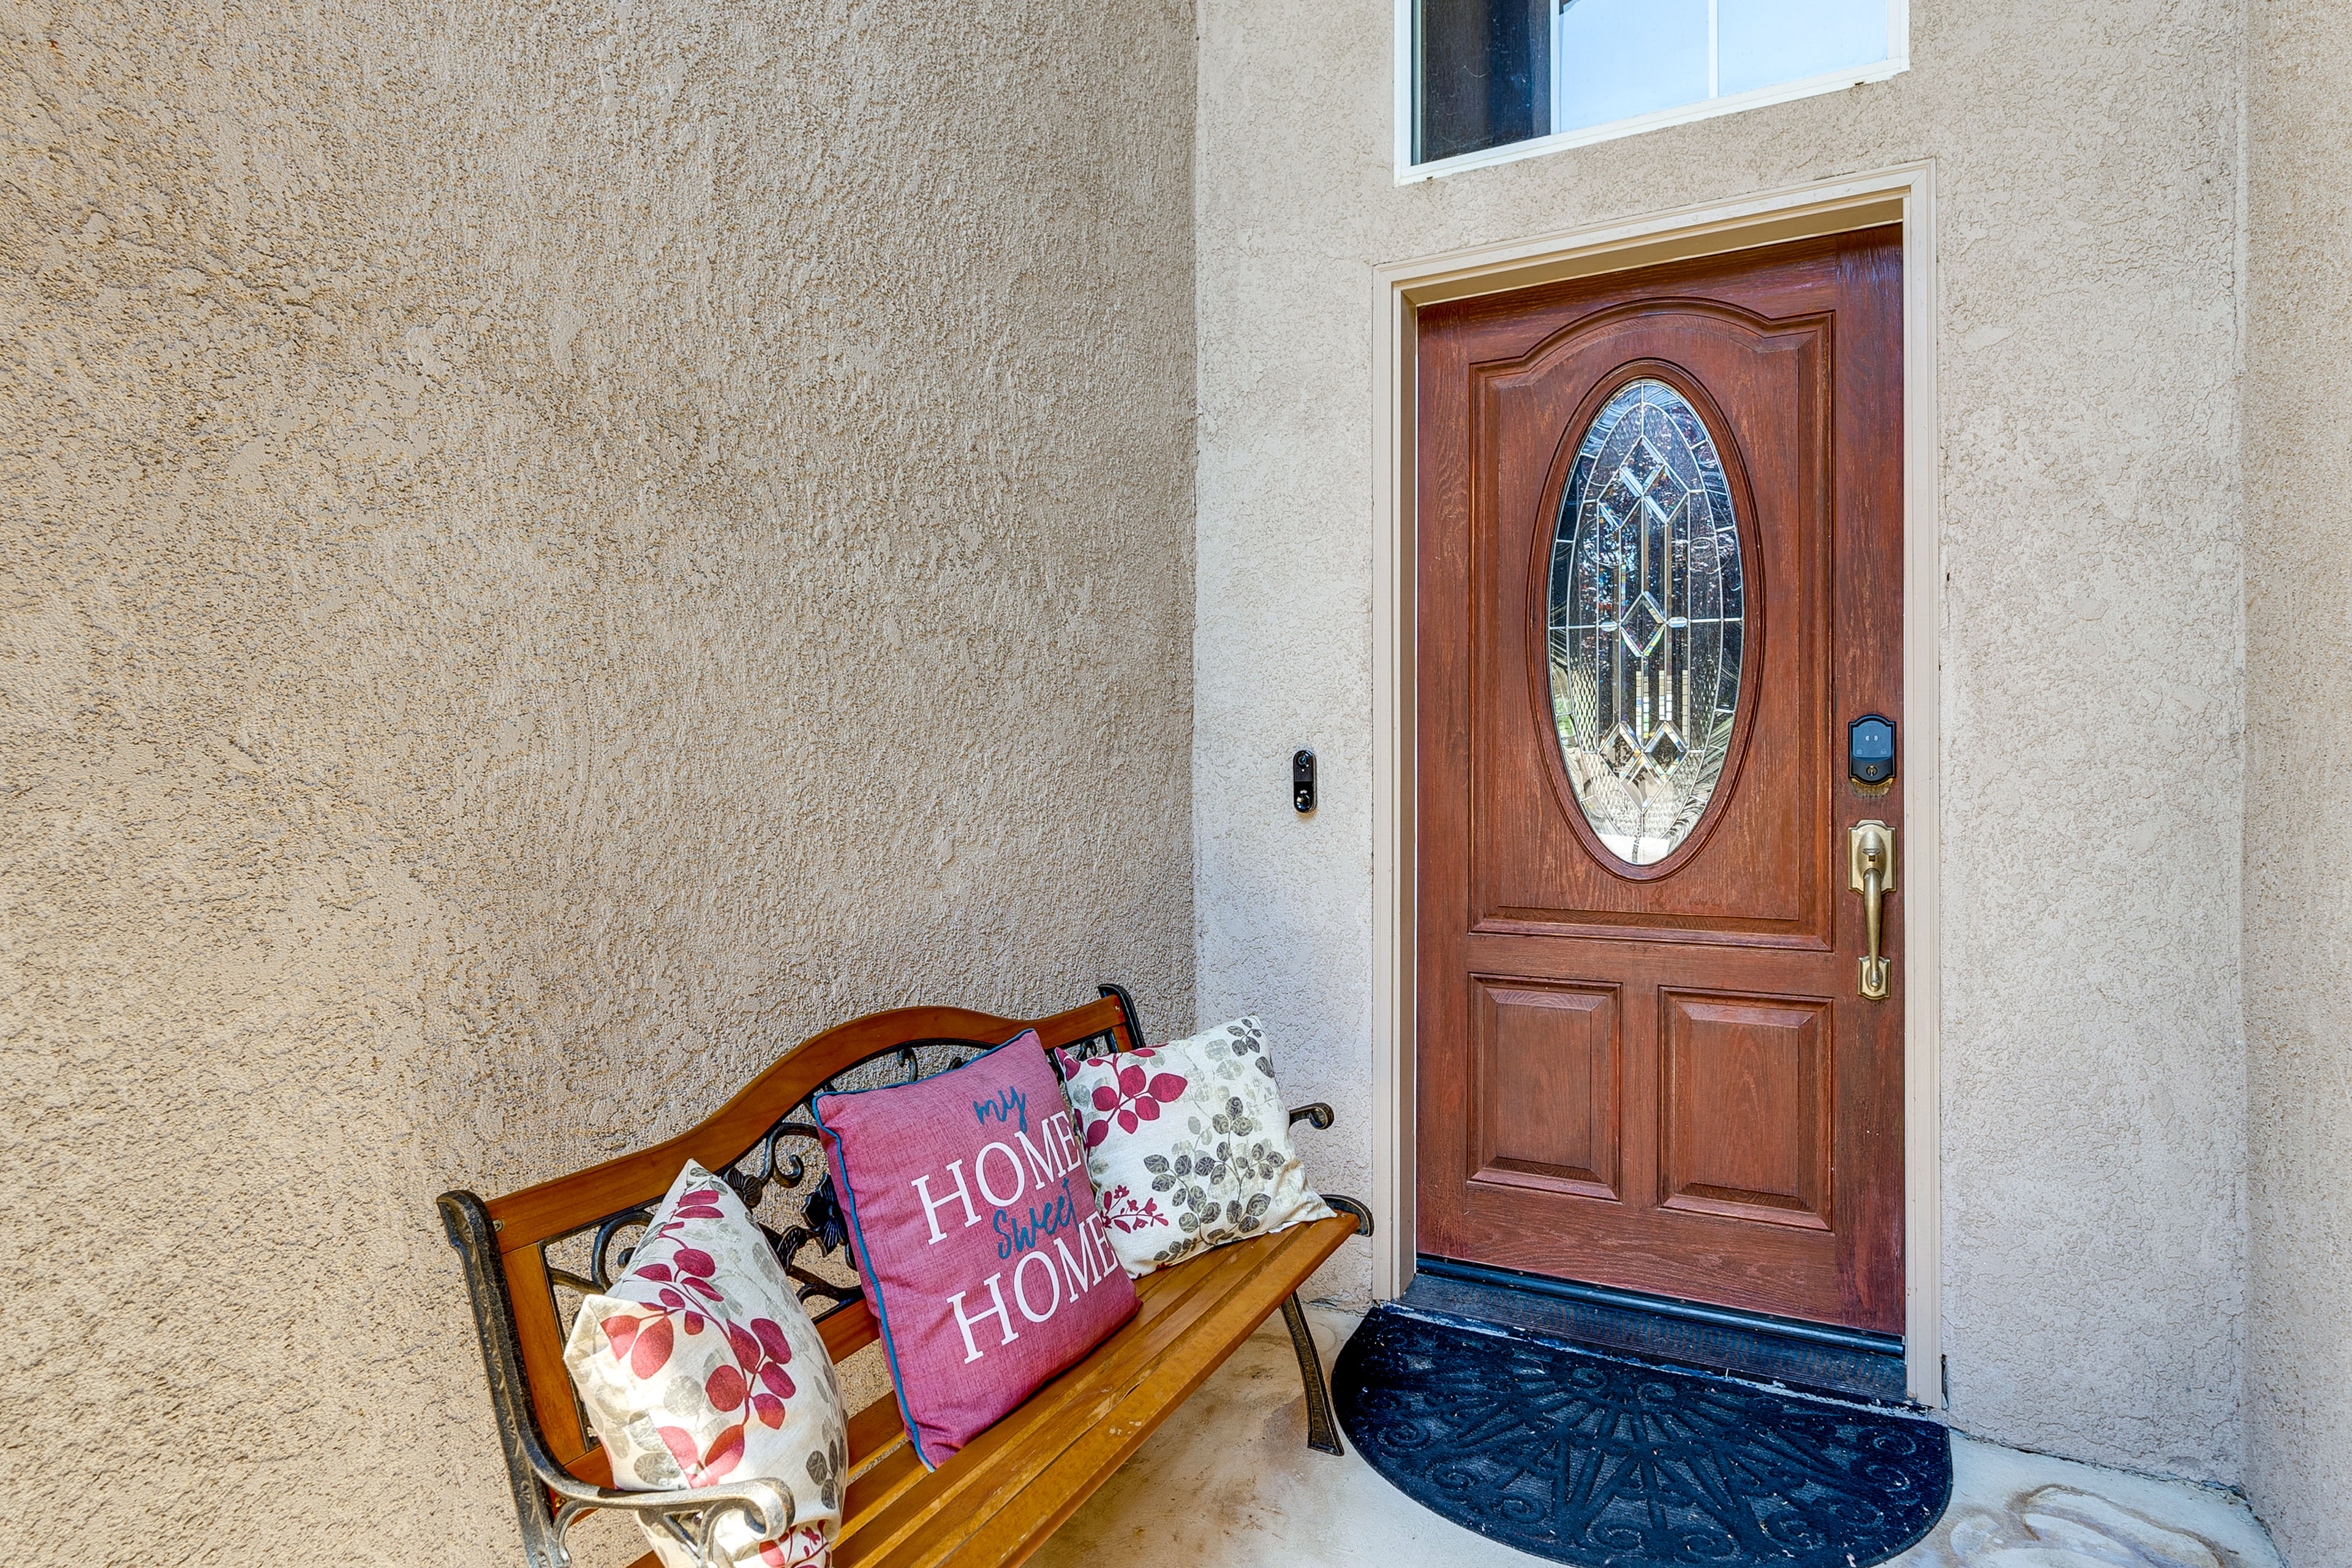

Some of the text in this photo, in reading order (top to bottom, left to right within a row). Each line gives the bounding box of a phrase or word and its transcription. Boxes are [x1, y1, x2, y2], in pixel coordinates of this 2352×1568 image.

[973, 1086, 1027, 1133] my
[911, 1110, 1082, 1245] HOME
[947, 1212, 1118, 1364] HOME
